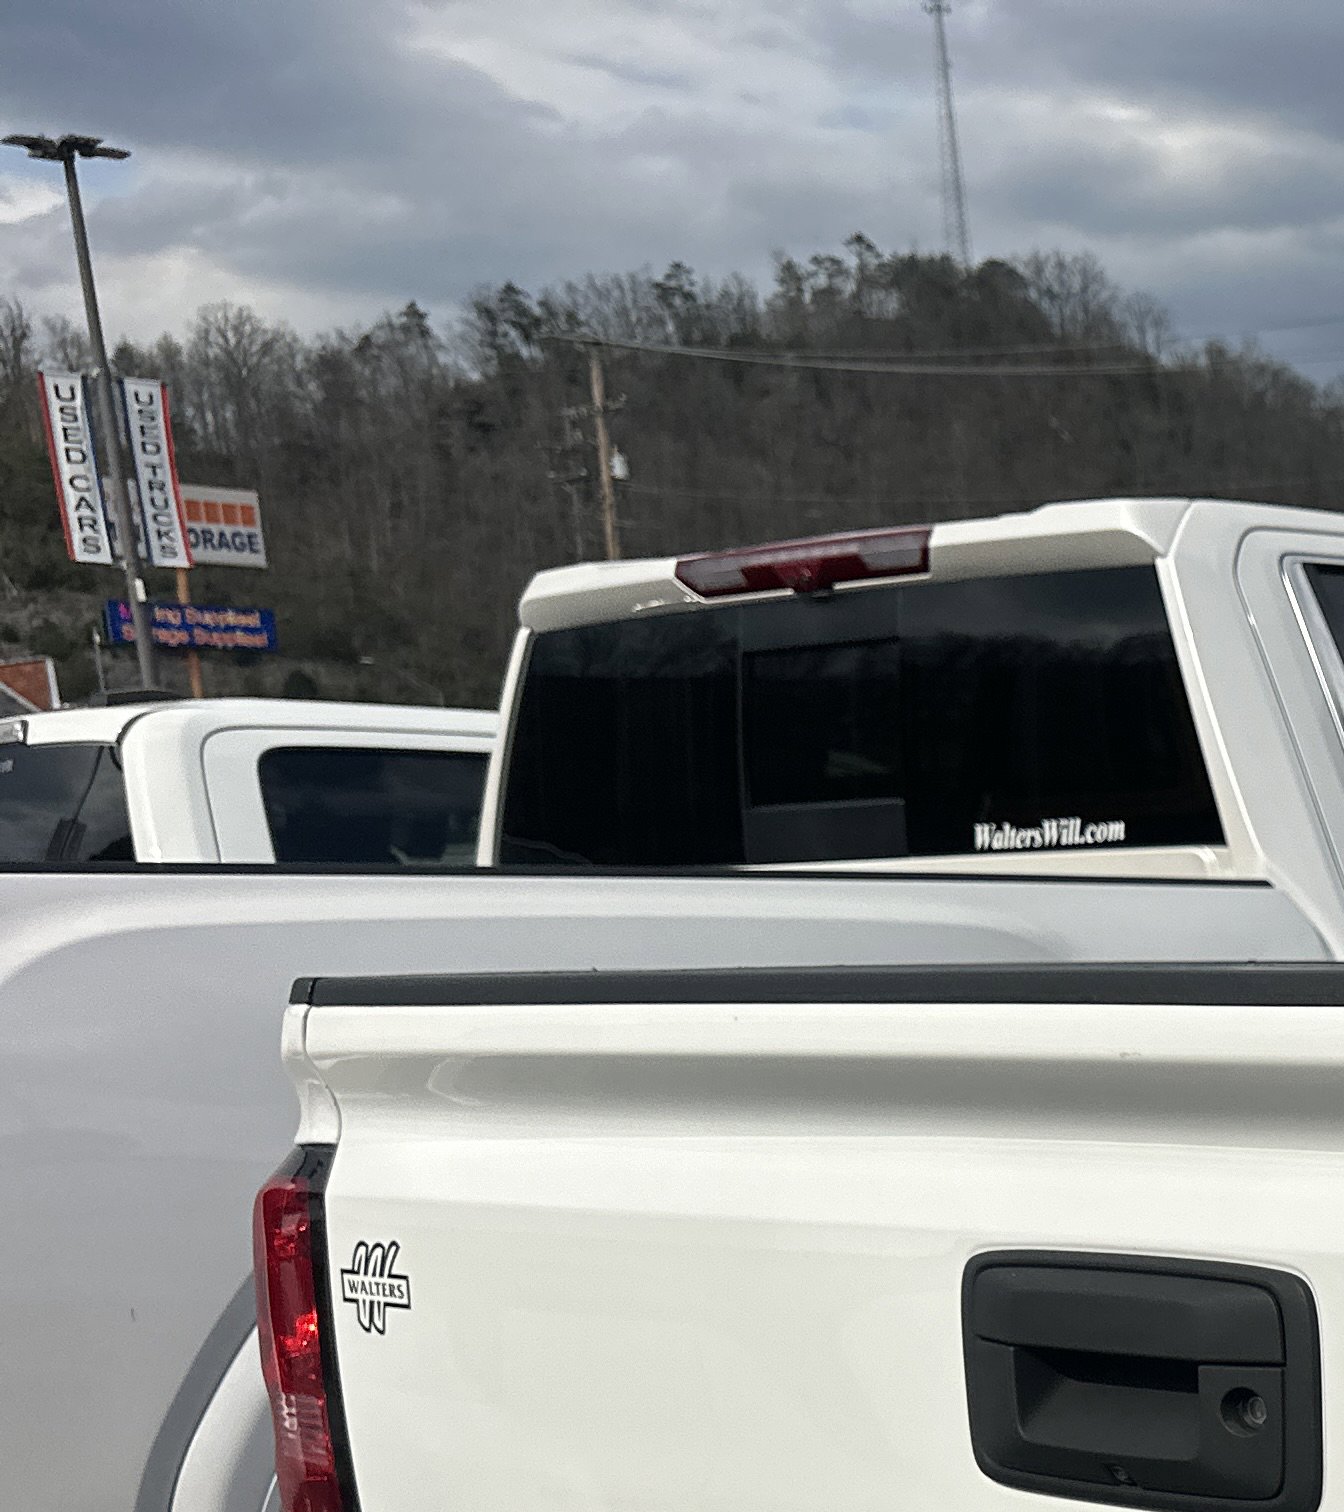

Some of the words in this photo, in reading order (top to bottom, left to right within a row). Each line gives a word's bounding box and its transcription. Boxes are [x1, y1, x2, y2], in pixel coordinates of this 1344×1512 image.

[53, 383, 87, 464] USED
[134, 390, 161, 456] USED
[69, 474, 101, 554] CARS
[144, 461, 178, 558] TRUCKS
[186, 527, 260, 553] ORAGE
[974, 816, 1126, 850] WaltersWill.com
[347, 1279, 405, 1300] WALTERS
